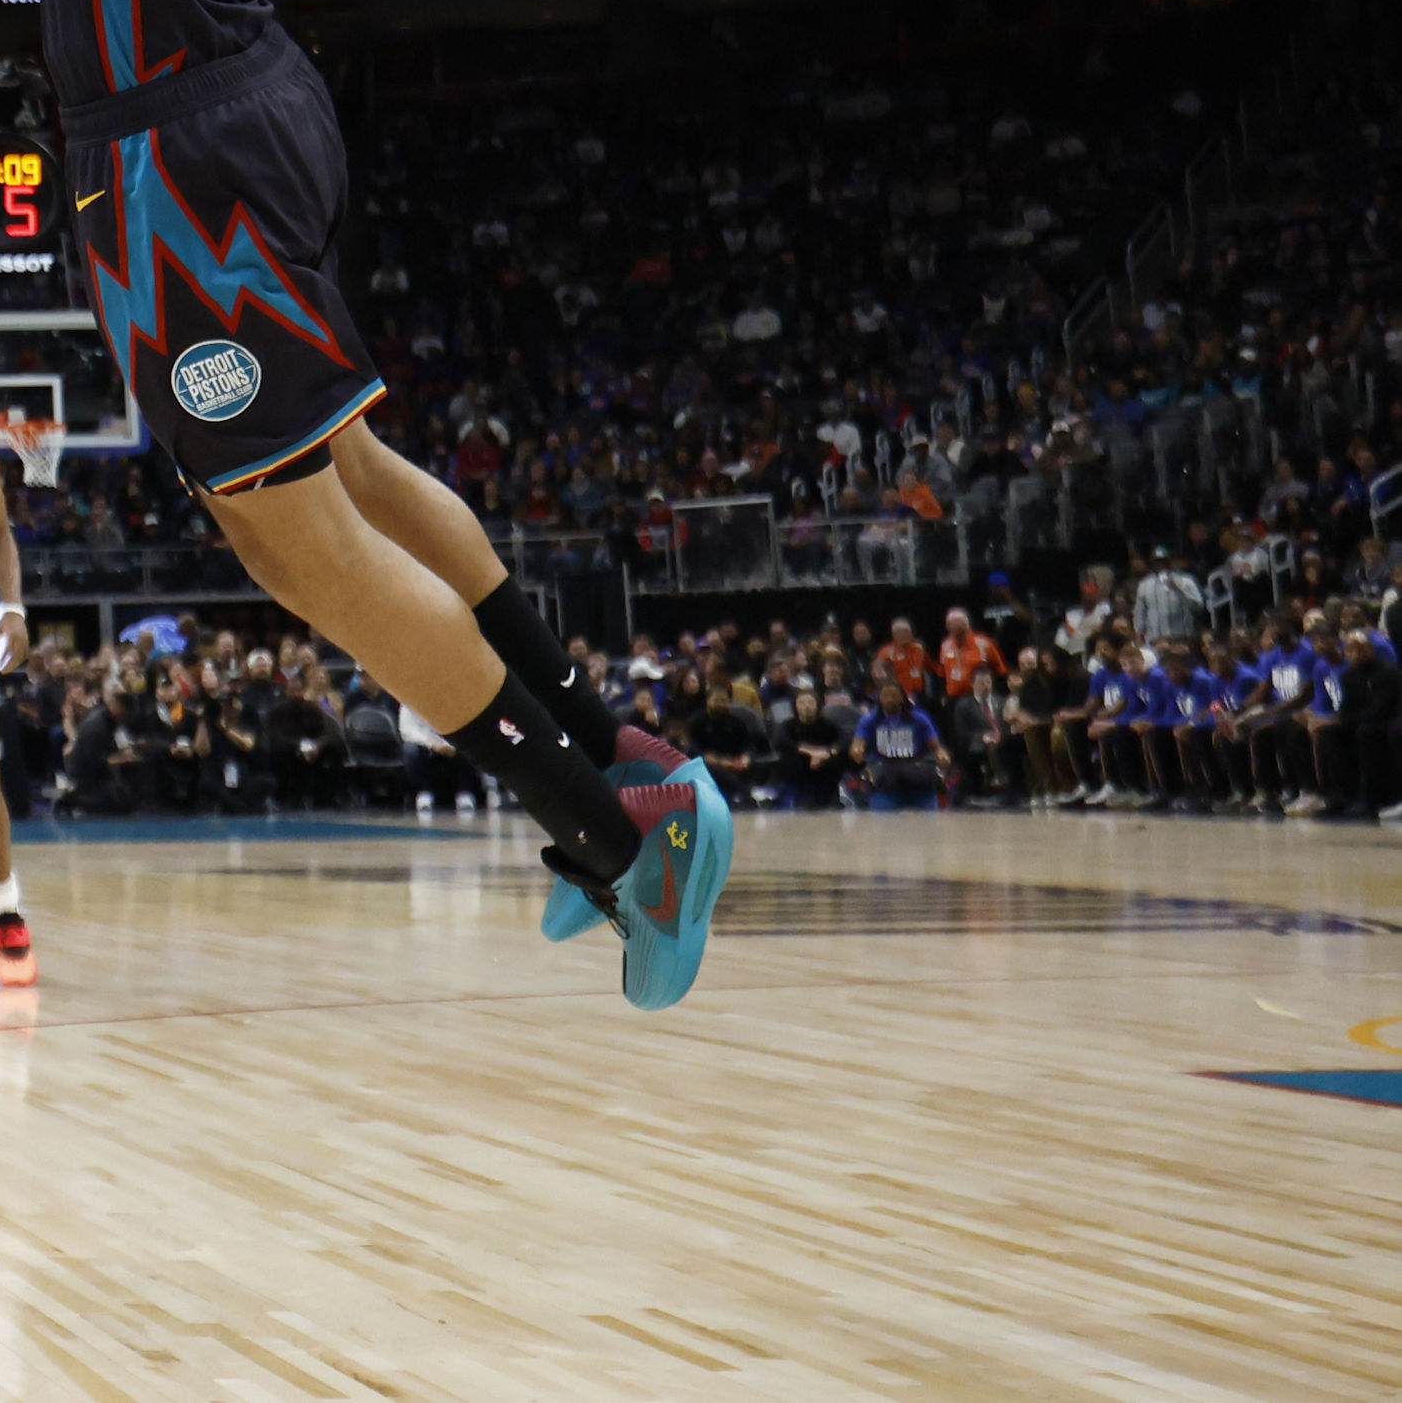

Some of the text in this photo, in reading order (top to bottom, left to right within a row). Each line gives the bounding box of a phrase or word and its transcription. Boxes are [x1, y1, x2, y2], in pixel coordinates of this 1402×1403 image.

[3, 185, 38, 237] 5
[180, 349, 239, 386] DETROIT
[188, 366, 250, 405] PISTONS
[196, 391, 237, 411] BASKETBALL
